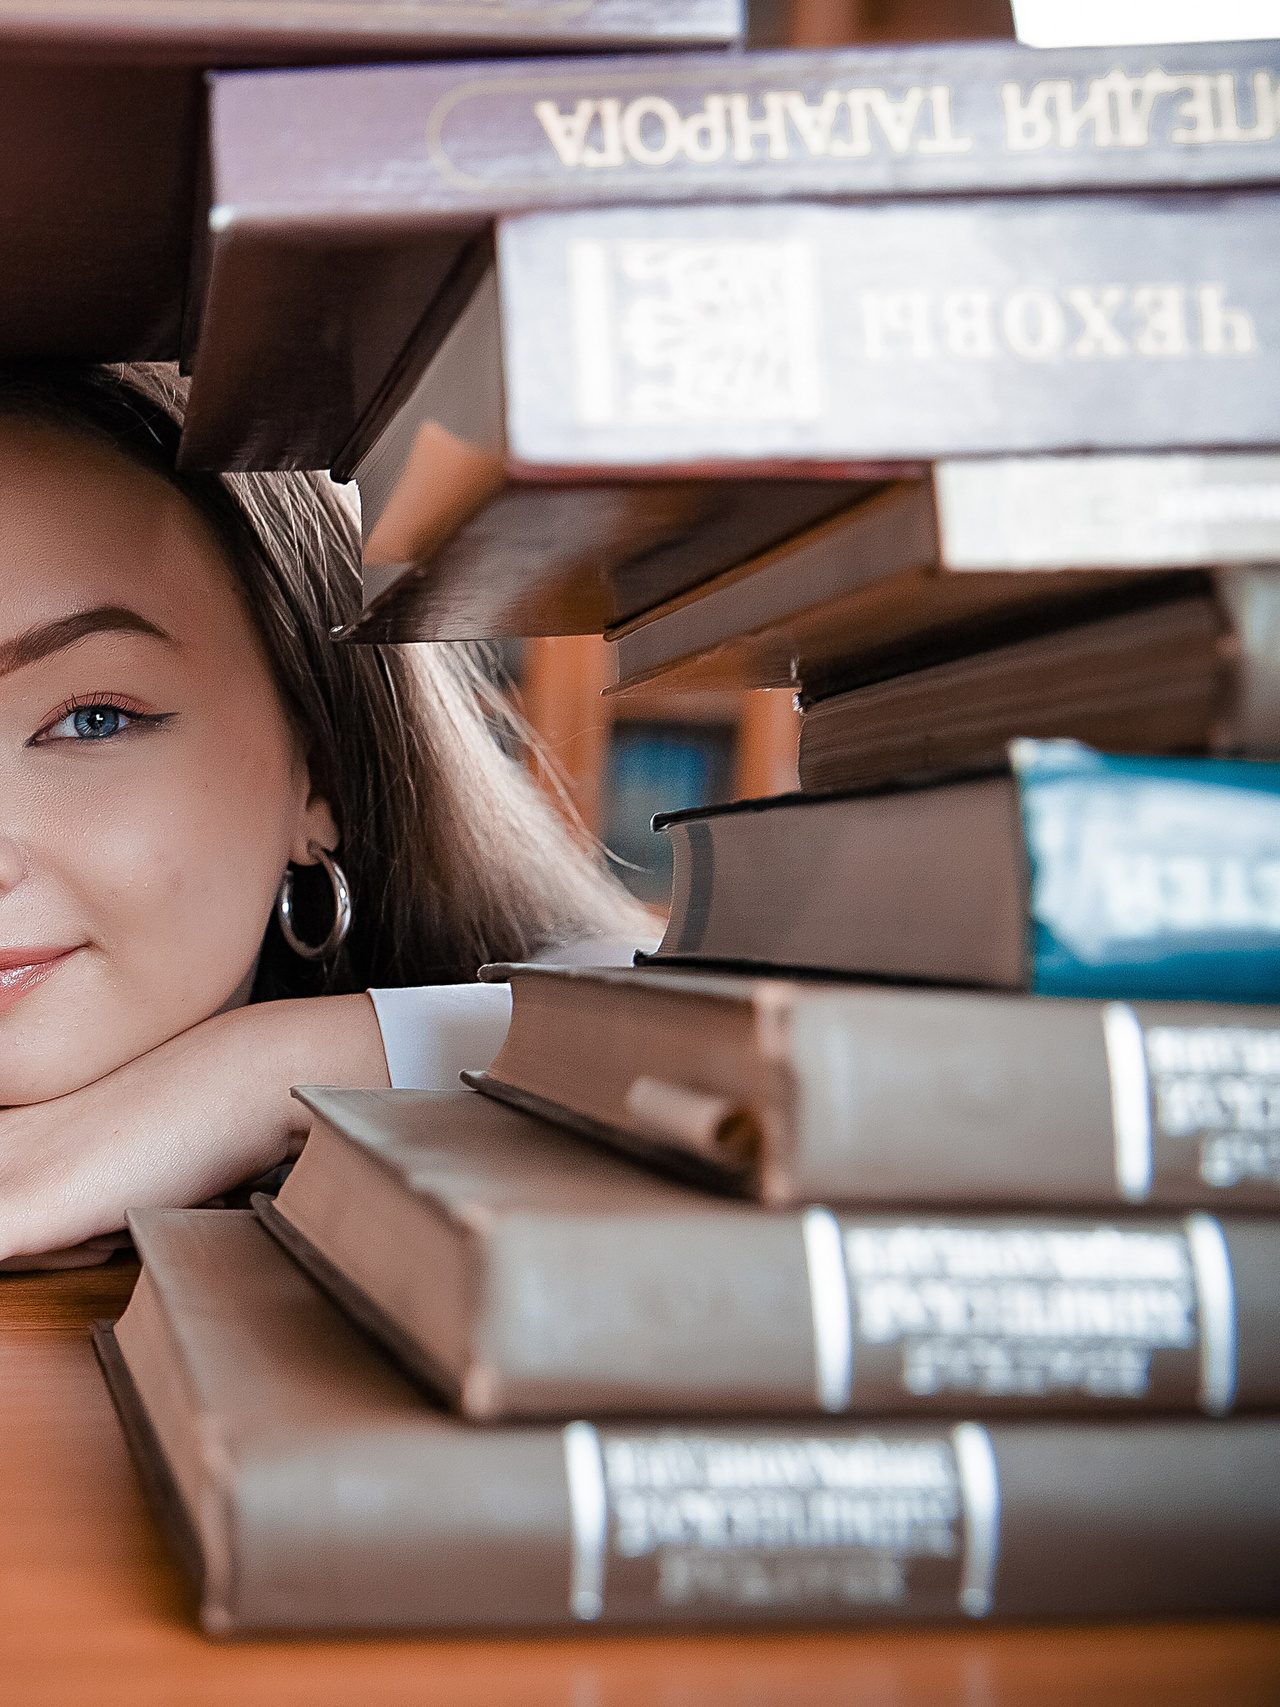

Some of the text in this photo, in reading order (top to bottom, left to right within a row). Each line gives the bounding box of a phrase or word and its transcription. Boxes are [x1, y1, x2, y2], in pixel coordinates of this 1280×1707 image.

[535, 68, 1280, 168] ПЕДИЯ ТАГАНРОГА
[860, 285, 1257, 360] ЧЕХОВЫ
